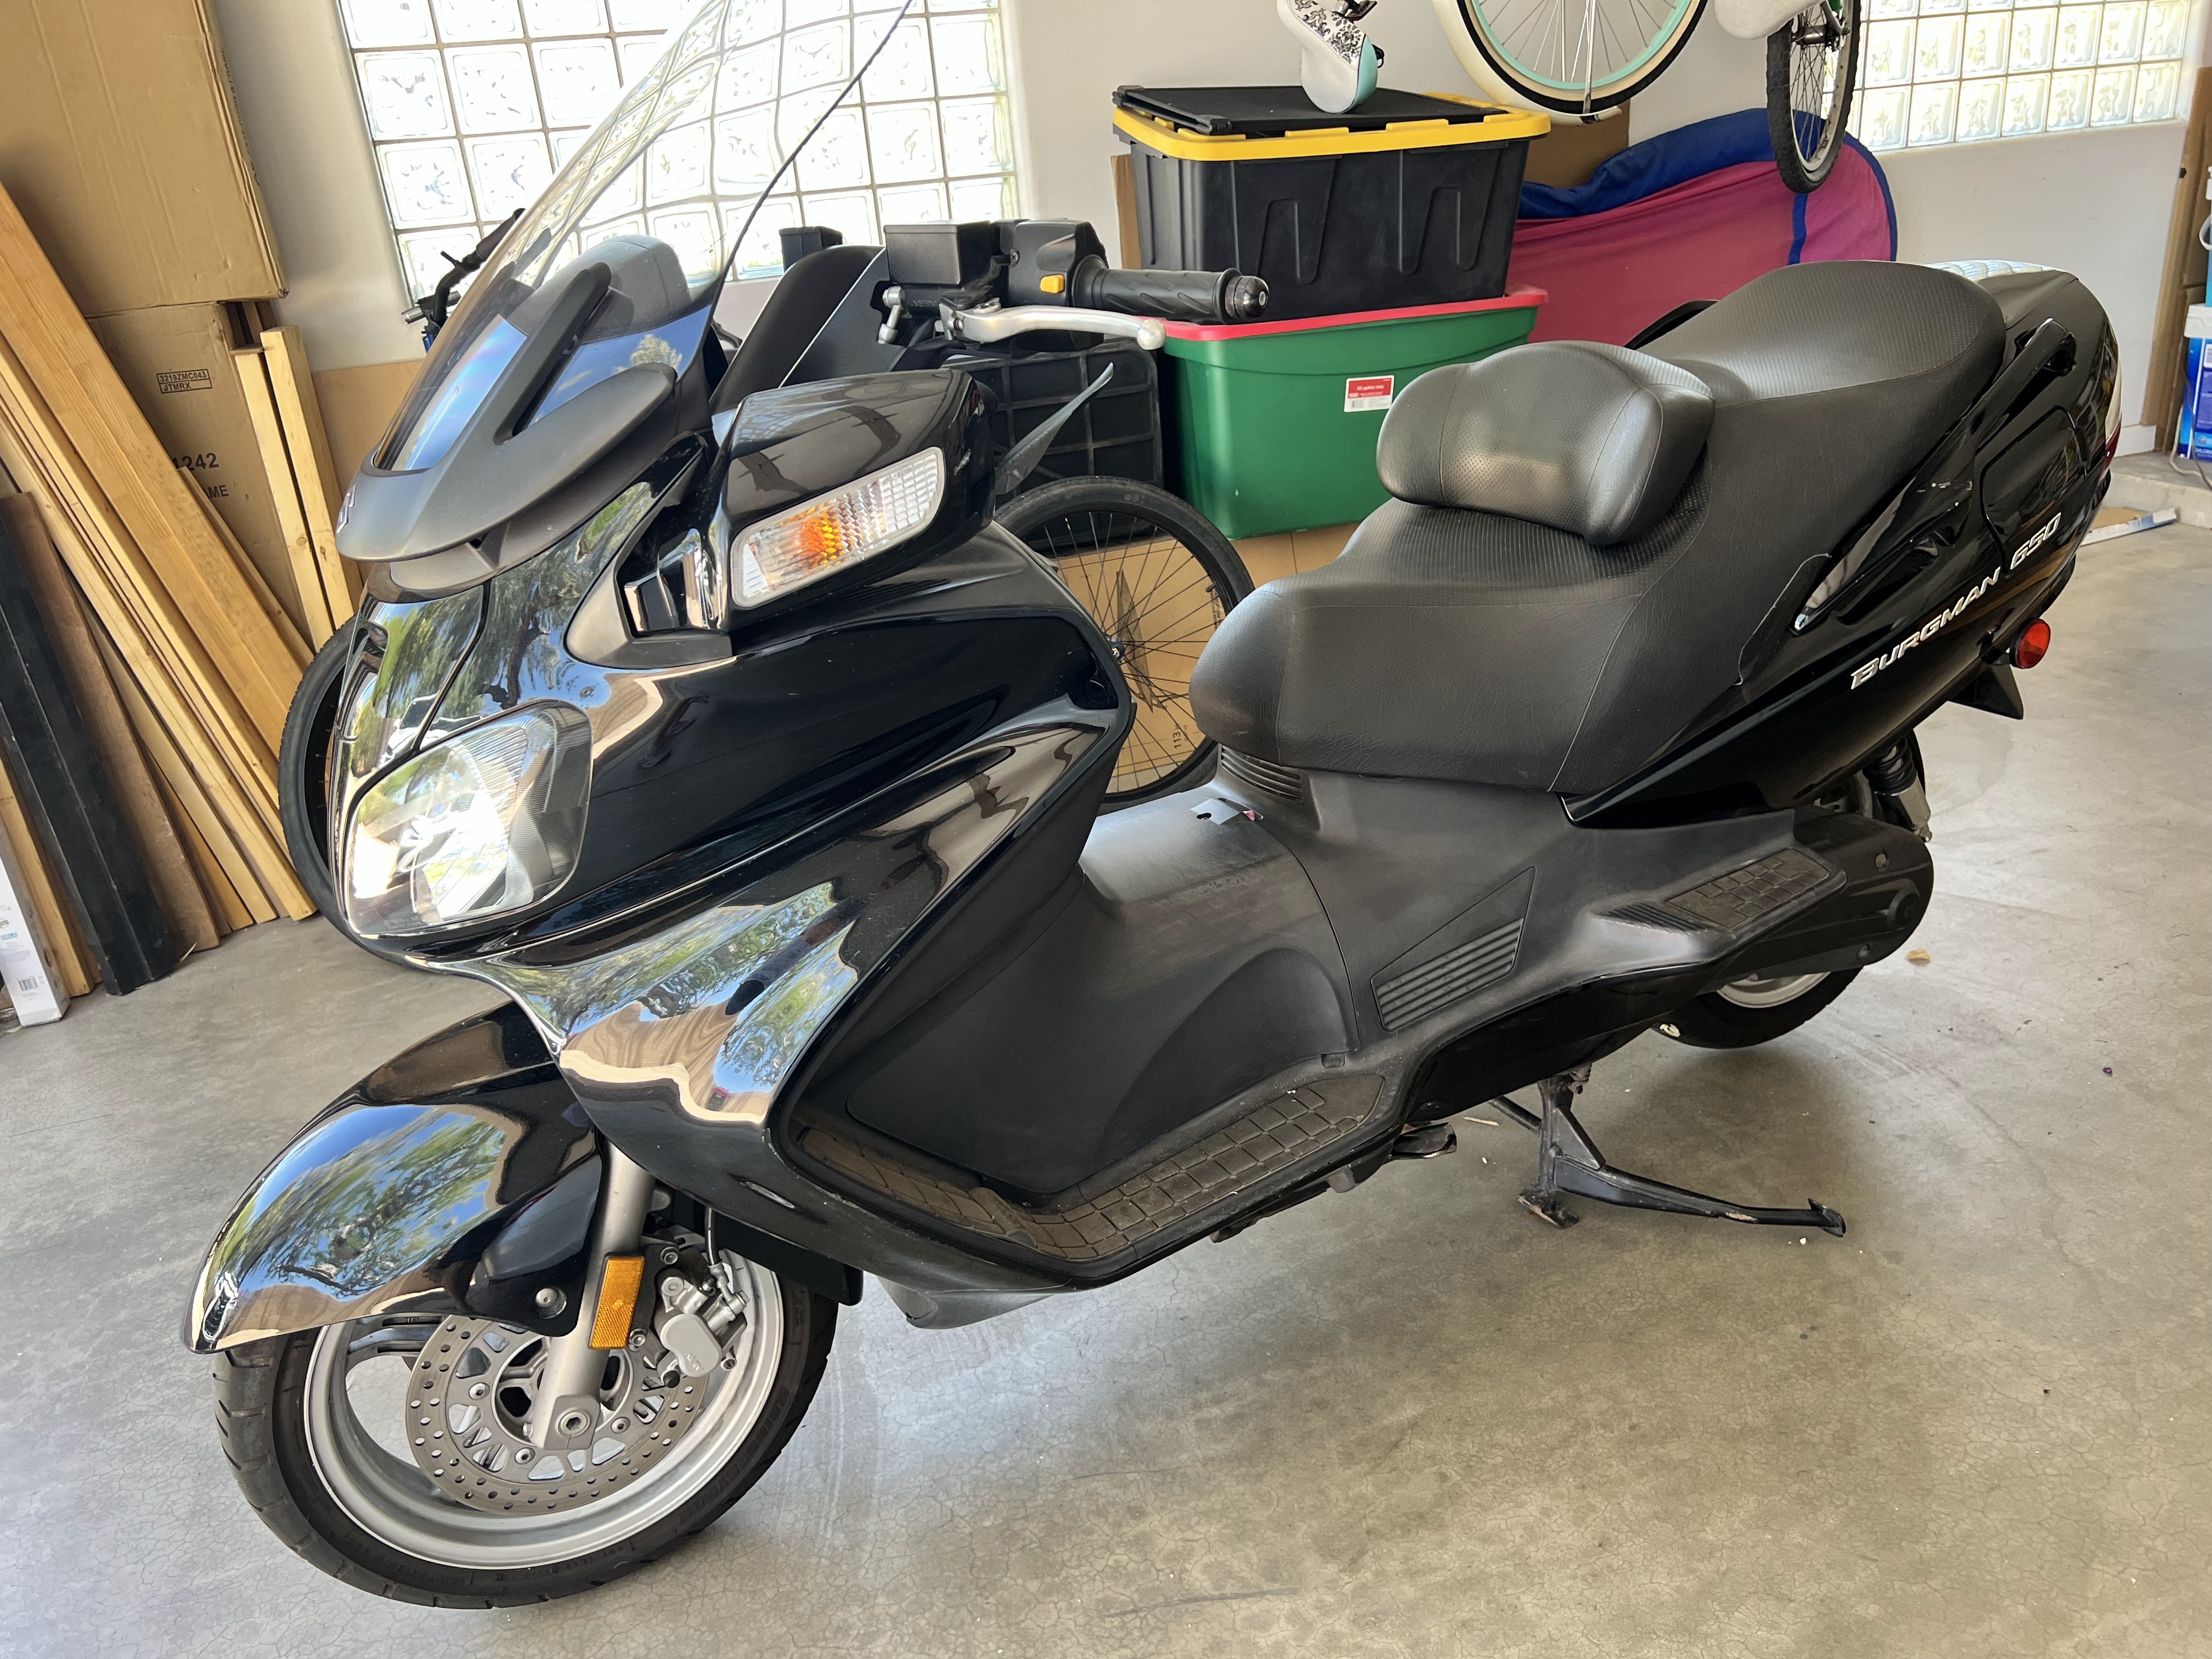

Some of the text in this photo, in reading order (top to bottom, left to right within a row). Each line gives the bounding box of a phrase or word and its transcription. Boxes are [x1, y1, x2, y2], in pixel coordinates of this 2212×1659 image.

[160, 371, 207, 382] 3219ZMC043
[163, 382, 191, 391] JTMRX
[1850, 512, 2062, 690] BURGMAN 650
[1172, 732, 1182, 749] 113
